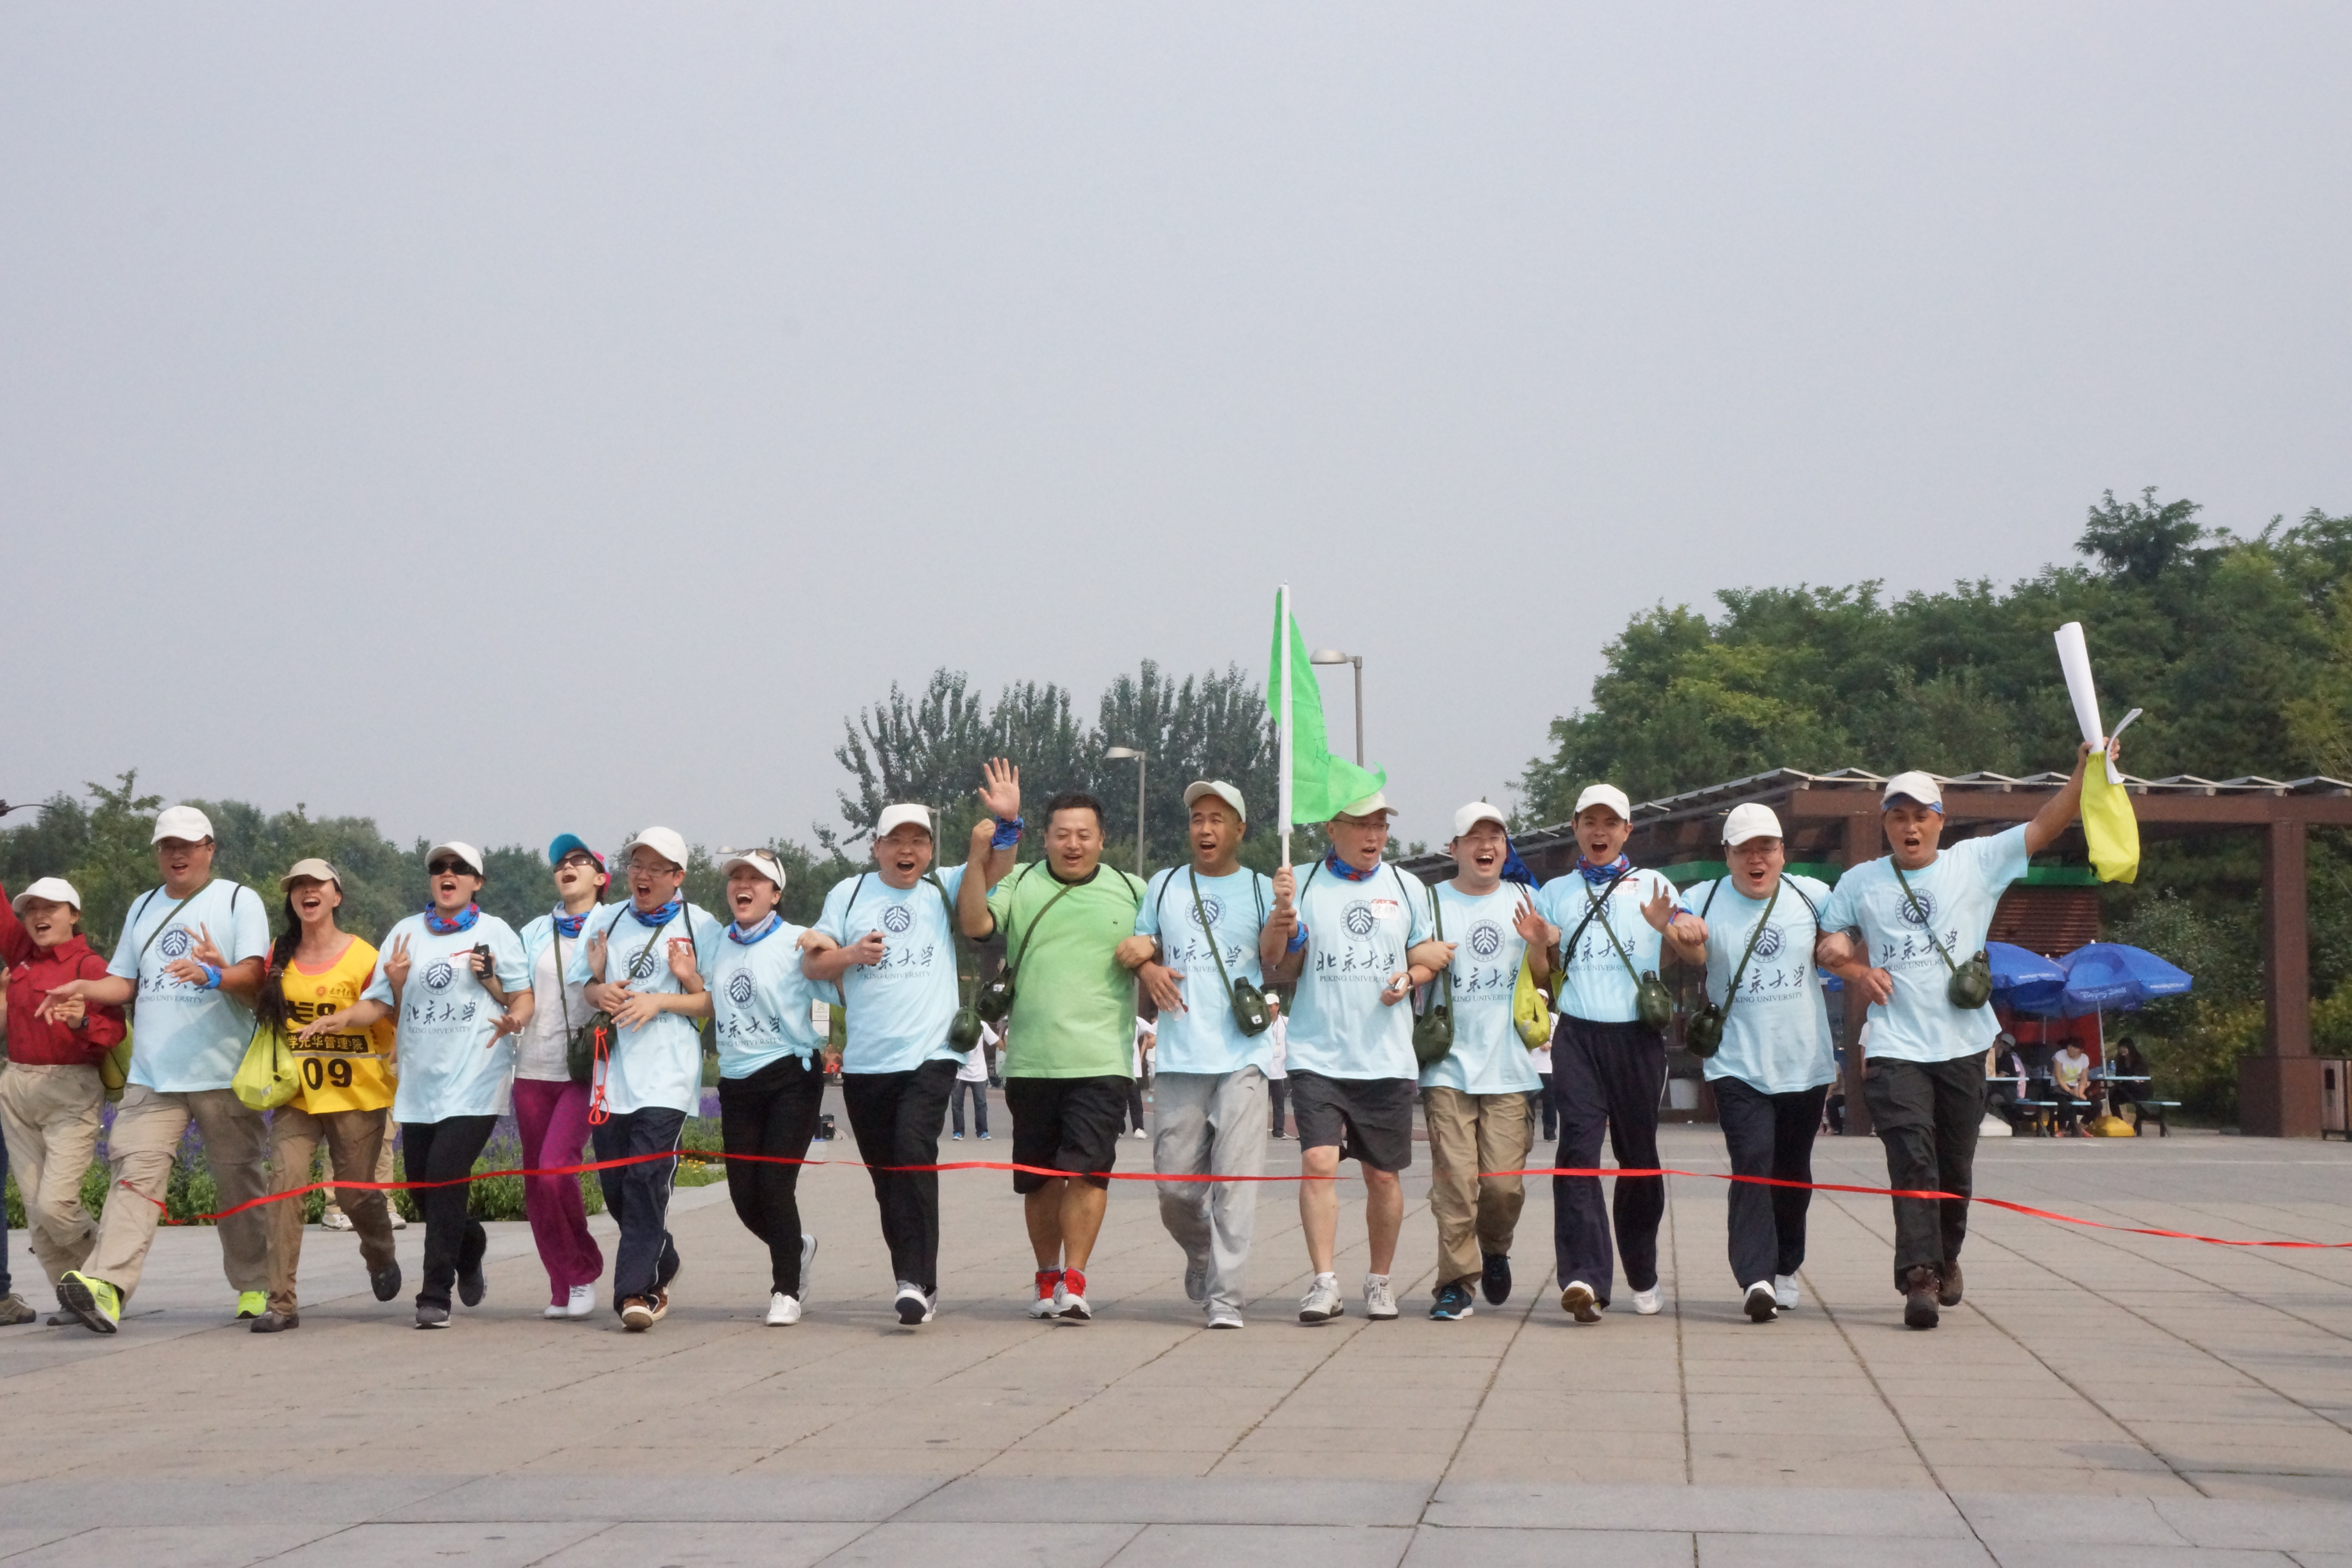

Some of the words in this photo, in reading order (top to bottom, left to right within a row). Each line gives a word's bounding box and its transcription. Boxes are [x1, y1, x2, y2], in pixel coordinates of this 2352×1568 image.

[1882, 927, 1957, 964] 北京大学
[857, 944, 933, 972] 京大学
[1316, 946, 1396, 974] 北京大学
[157, 995, 203, 1004] UNIVERSITY
[1757, 992, 1802, 1002] UNIVERSITY
[407, 999, 475, 1024] 北京大学
[428, 1026, 471, 1034] UNIVERSITY
[735, 1036, 782, 1047] UNIVERSITY
